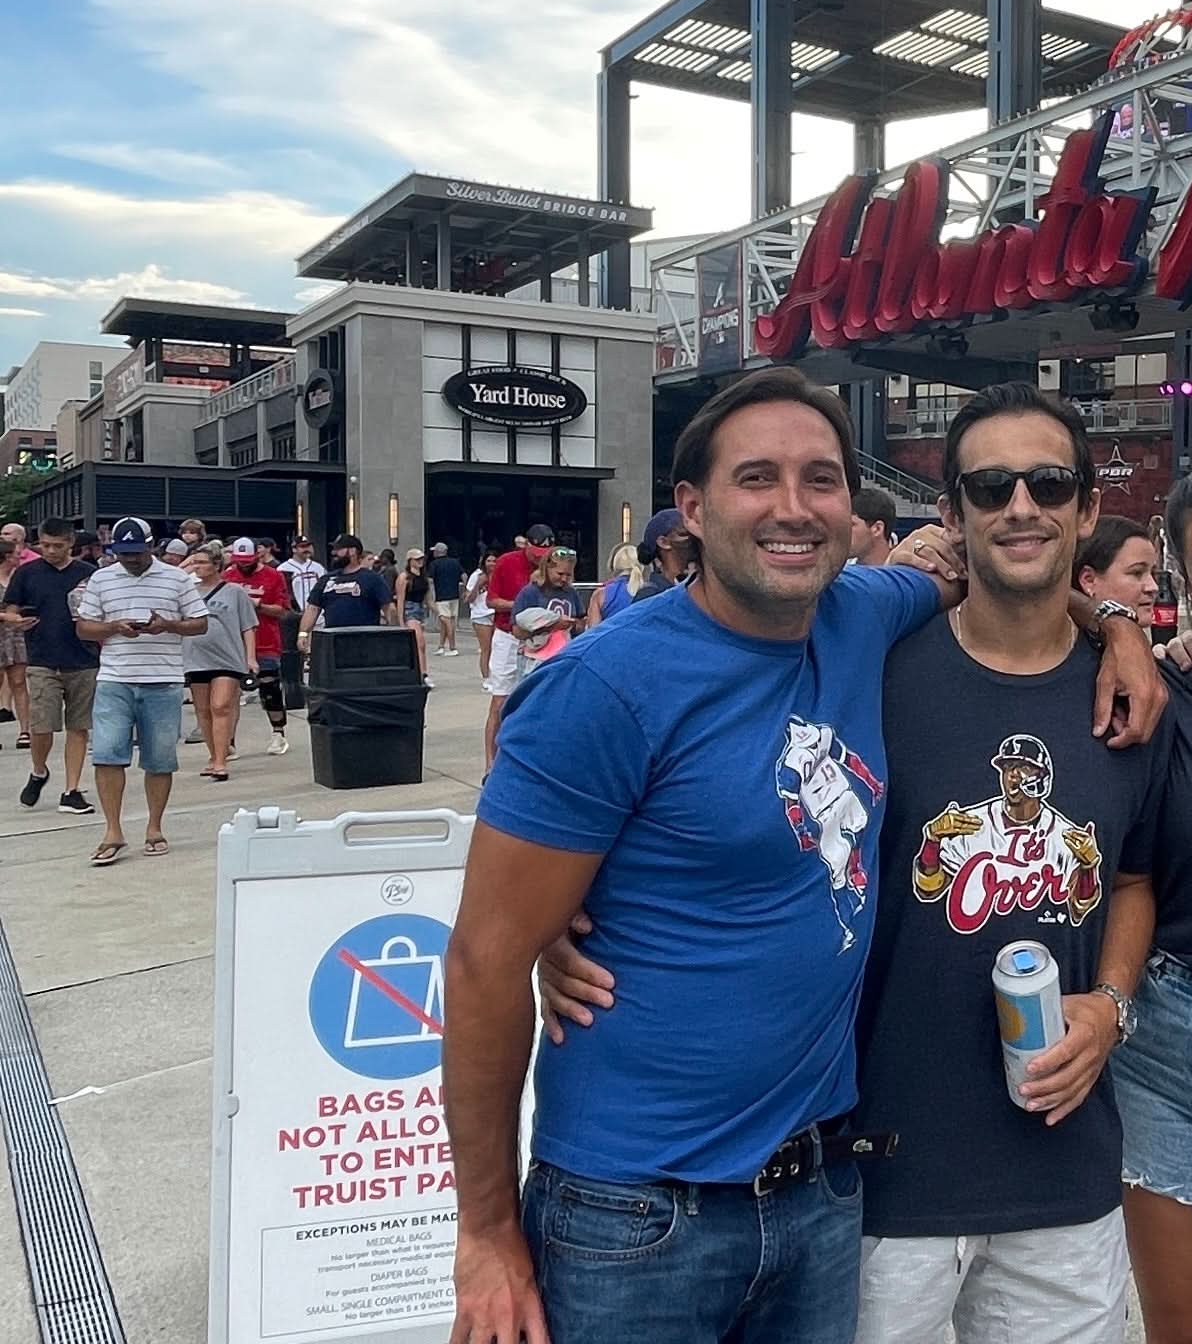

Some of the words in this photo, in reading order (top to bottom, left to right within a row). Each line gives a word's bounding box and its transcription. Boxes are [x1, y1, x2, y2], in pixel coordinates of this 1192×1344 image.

[446, 181, 492, 202] Silver
[492, 187, 541, 210] Bullet
[543, 200, 595, 217] BRIDGE
[600, 209, 628, 223] BAR
[754, 109, 1160, 358] Atlanta
[470, 383, 510, 405] Yard
[513, 386, 567, 409] House
[947, 851, 1070, 934] Over
[319, 1089, 405, 1118] BAGS
[279, 1123, 347, 1152] NOT
[357, 1114, 441, 1143] ALLO
[320, 1151, 364, 1176] TO
[374, 1142, 454, 1171] ENTE
[293, 1175, 408, 1209] TRUIST
[417, 1170, 457, 1195] PA
[296, 1221, 378, 1241] EXCEPTIONS
[381, 1218, 408, 1231] MAY
[411, 1216, 428, 1226] BE
[431, 1212, 458, 1224] MAD
[366, 1234, 406, 1247] MEDICAL
[409, 1232, 432, 1243] BAGS
[370, 1269, 403, 1282] DIAPER
[405, 1266, 429, 1277] BAGS
[341, 1298, 373, 1311] SINGLE
[375, 1288, 444, 1308] COMPARTMENT
